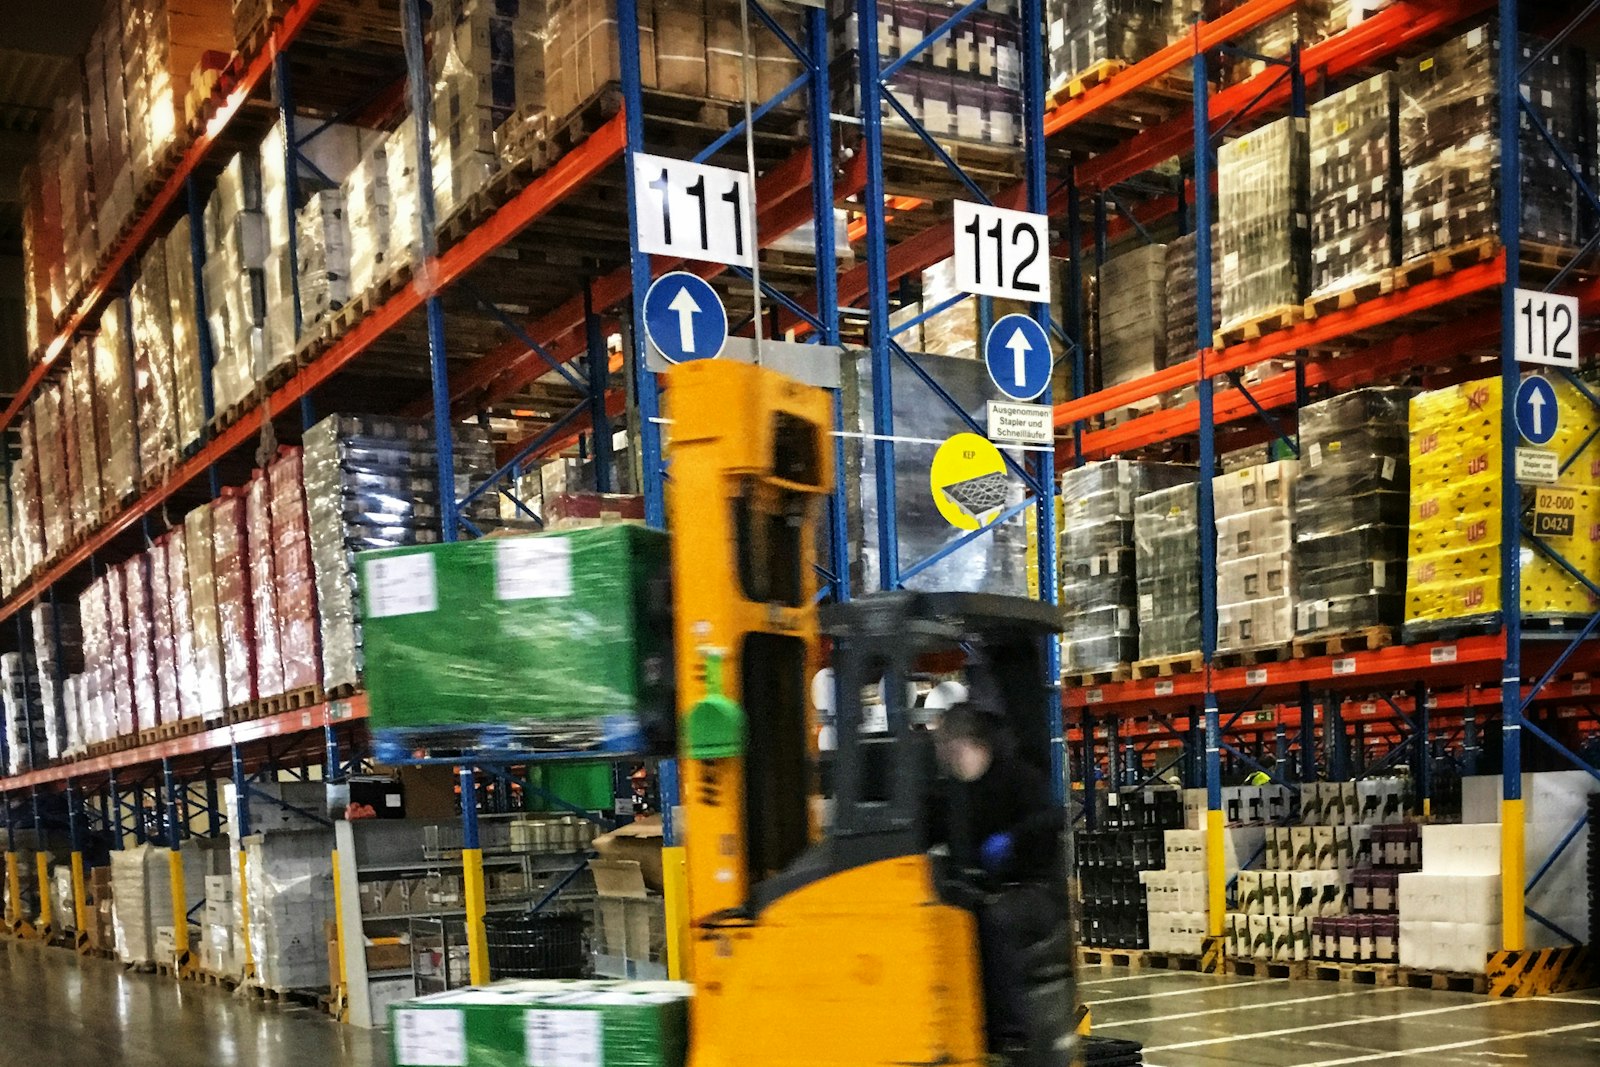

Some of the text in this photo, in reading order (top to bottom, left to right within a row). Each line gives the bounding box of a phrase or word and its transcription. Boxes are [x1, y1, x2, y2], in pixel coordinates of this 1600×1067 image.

[648, 168, 743, 256] 111
[965, 213, 1040, 292] 112
[1521, 298, 1572, 359] 112
[992, 404, 1049, 418] Ausgenommen
[999, 416, 1043, 428] Stapler und
[963, 450, 976, 460] KEP
[1540, 494, 1574, 510] 02-000
